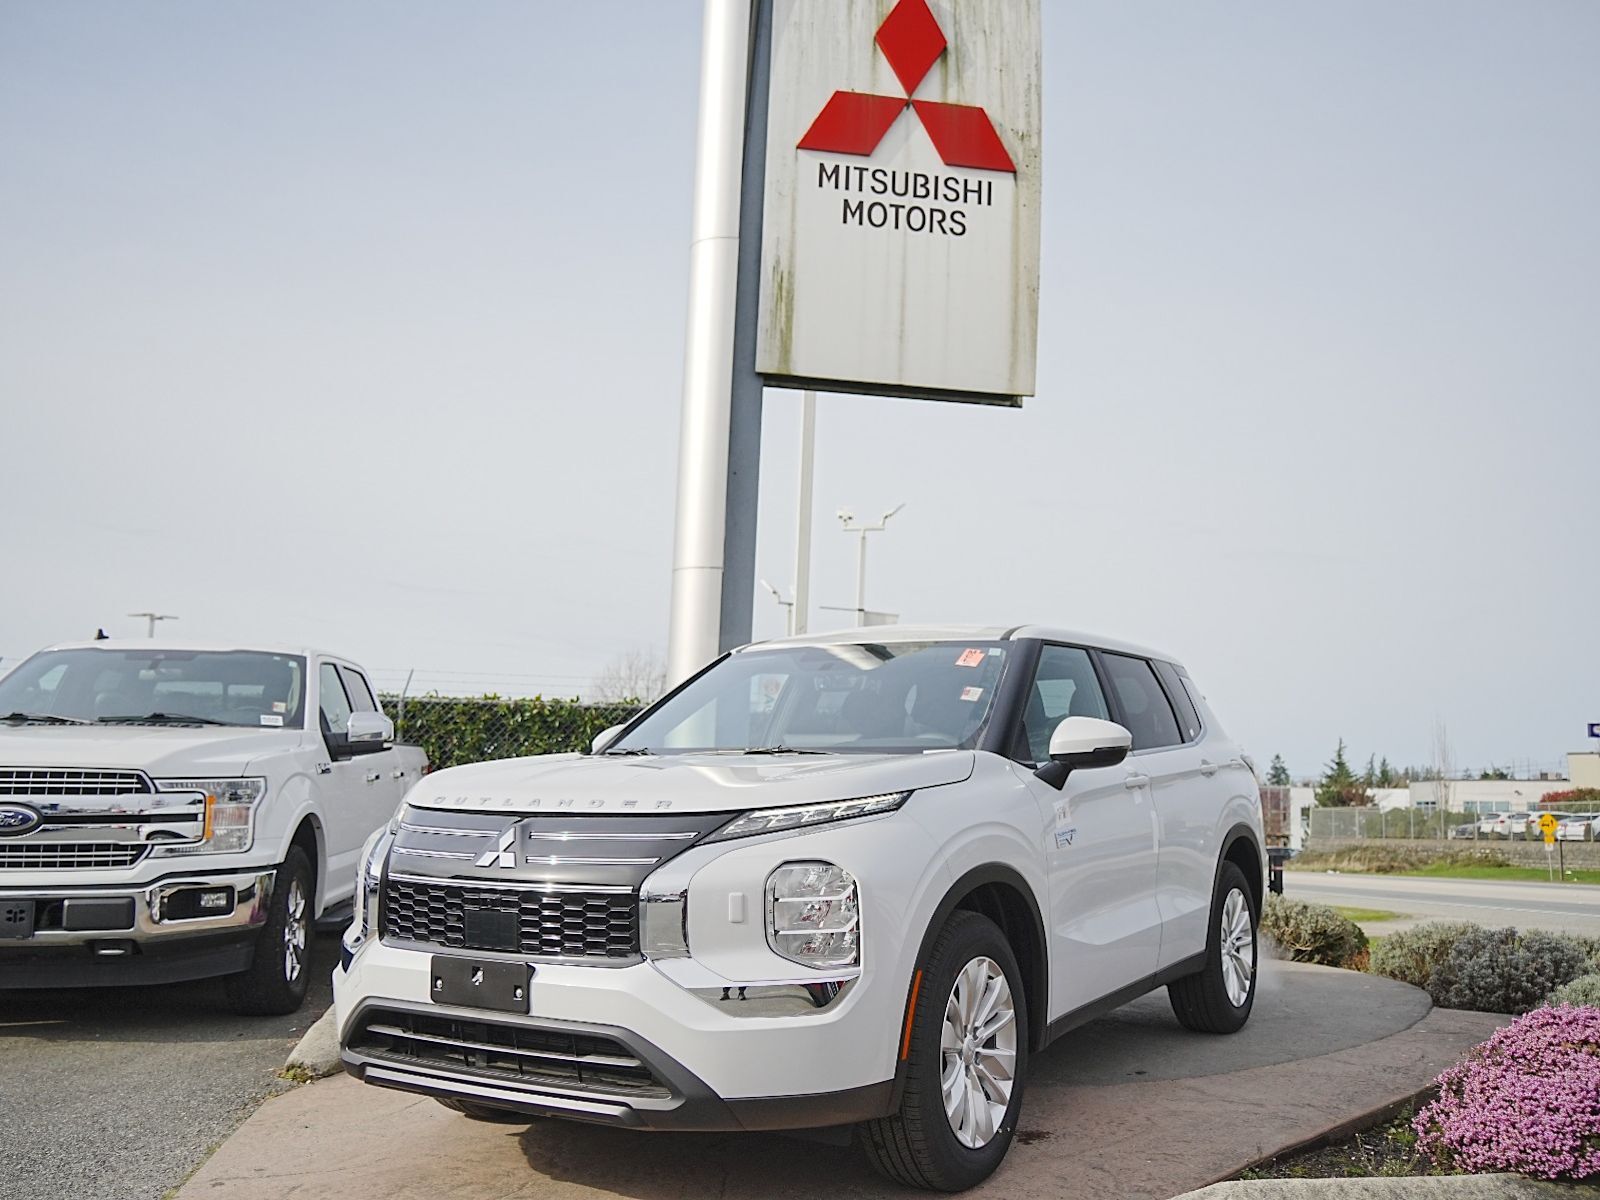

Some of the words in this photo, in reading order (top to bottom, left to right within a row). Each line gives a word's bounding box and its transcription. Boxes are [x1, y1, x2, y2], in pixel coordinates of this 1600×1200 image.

[818, 163, 992, 206] MITSUBISHI
[842, 199, 966, 236] MOTORS
[433, 796, 673, 809] OUTLANDER
